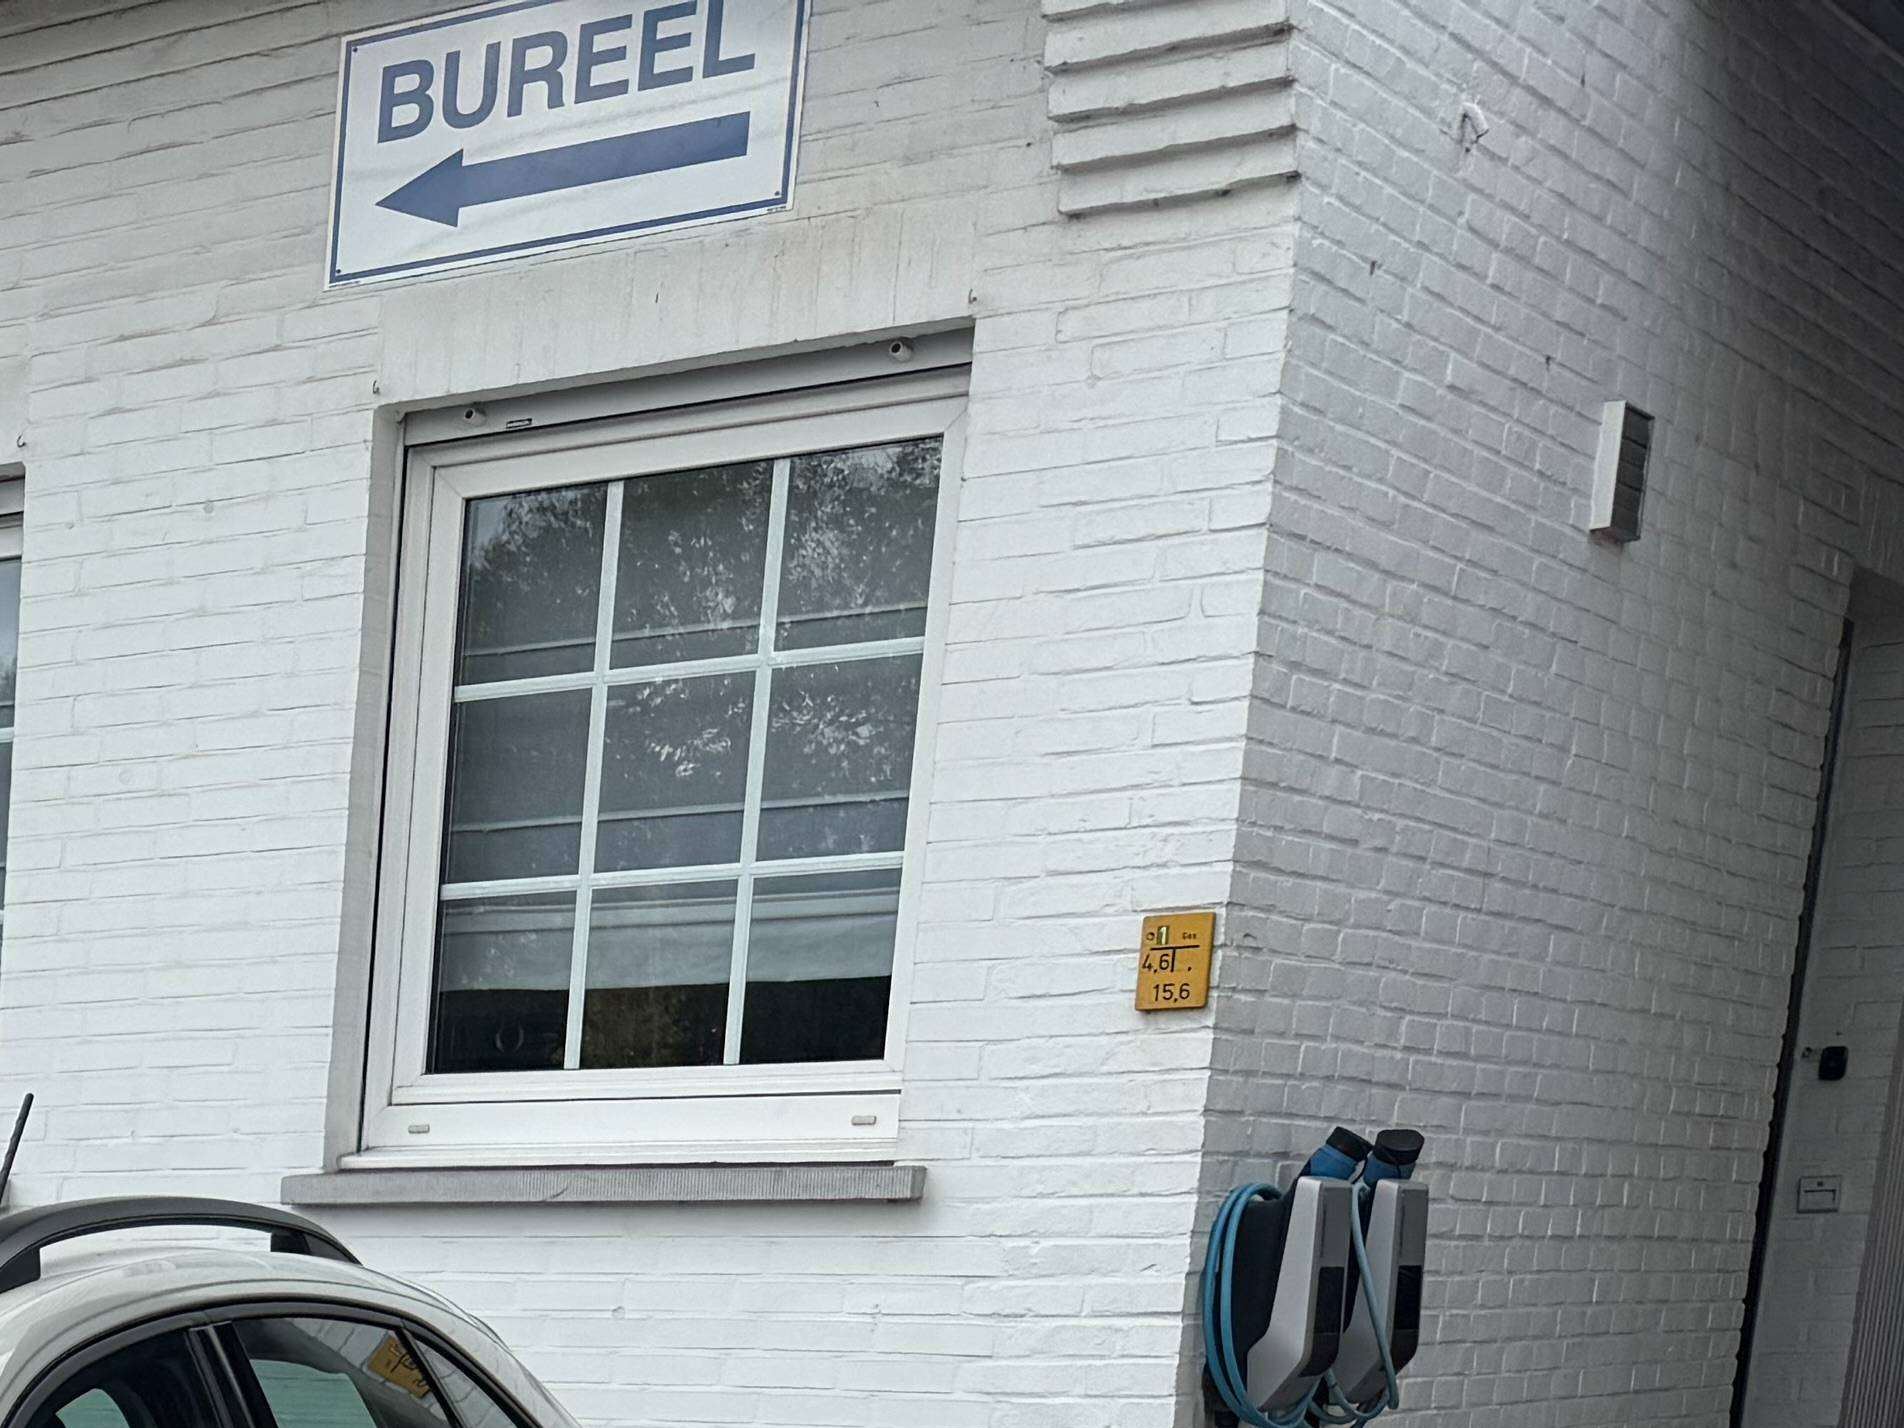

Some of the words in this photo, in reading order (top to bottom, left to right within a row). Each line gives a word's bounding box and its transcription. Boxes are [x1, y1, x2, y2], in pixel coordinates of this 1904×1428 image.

[378, 0, 756, 144] BUREEL
[1141, 953, 1171, 974] 4,6
[1152, 983, 1191, 1003] 15,6
